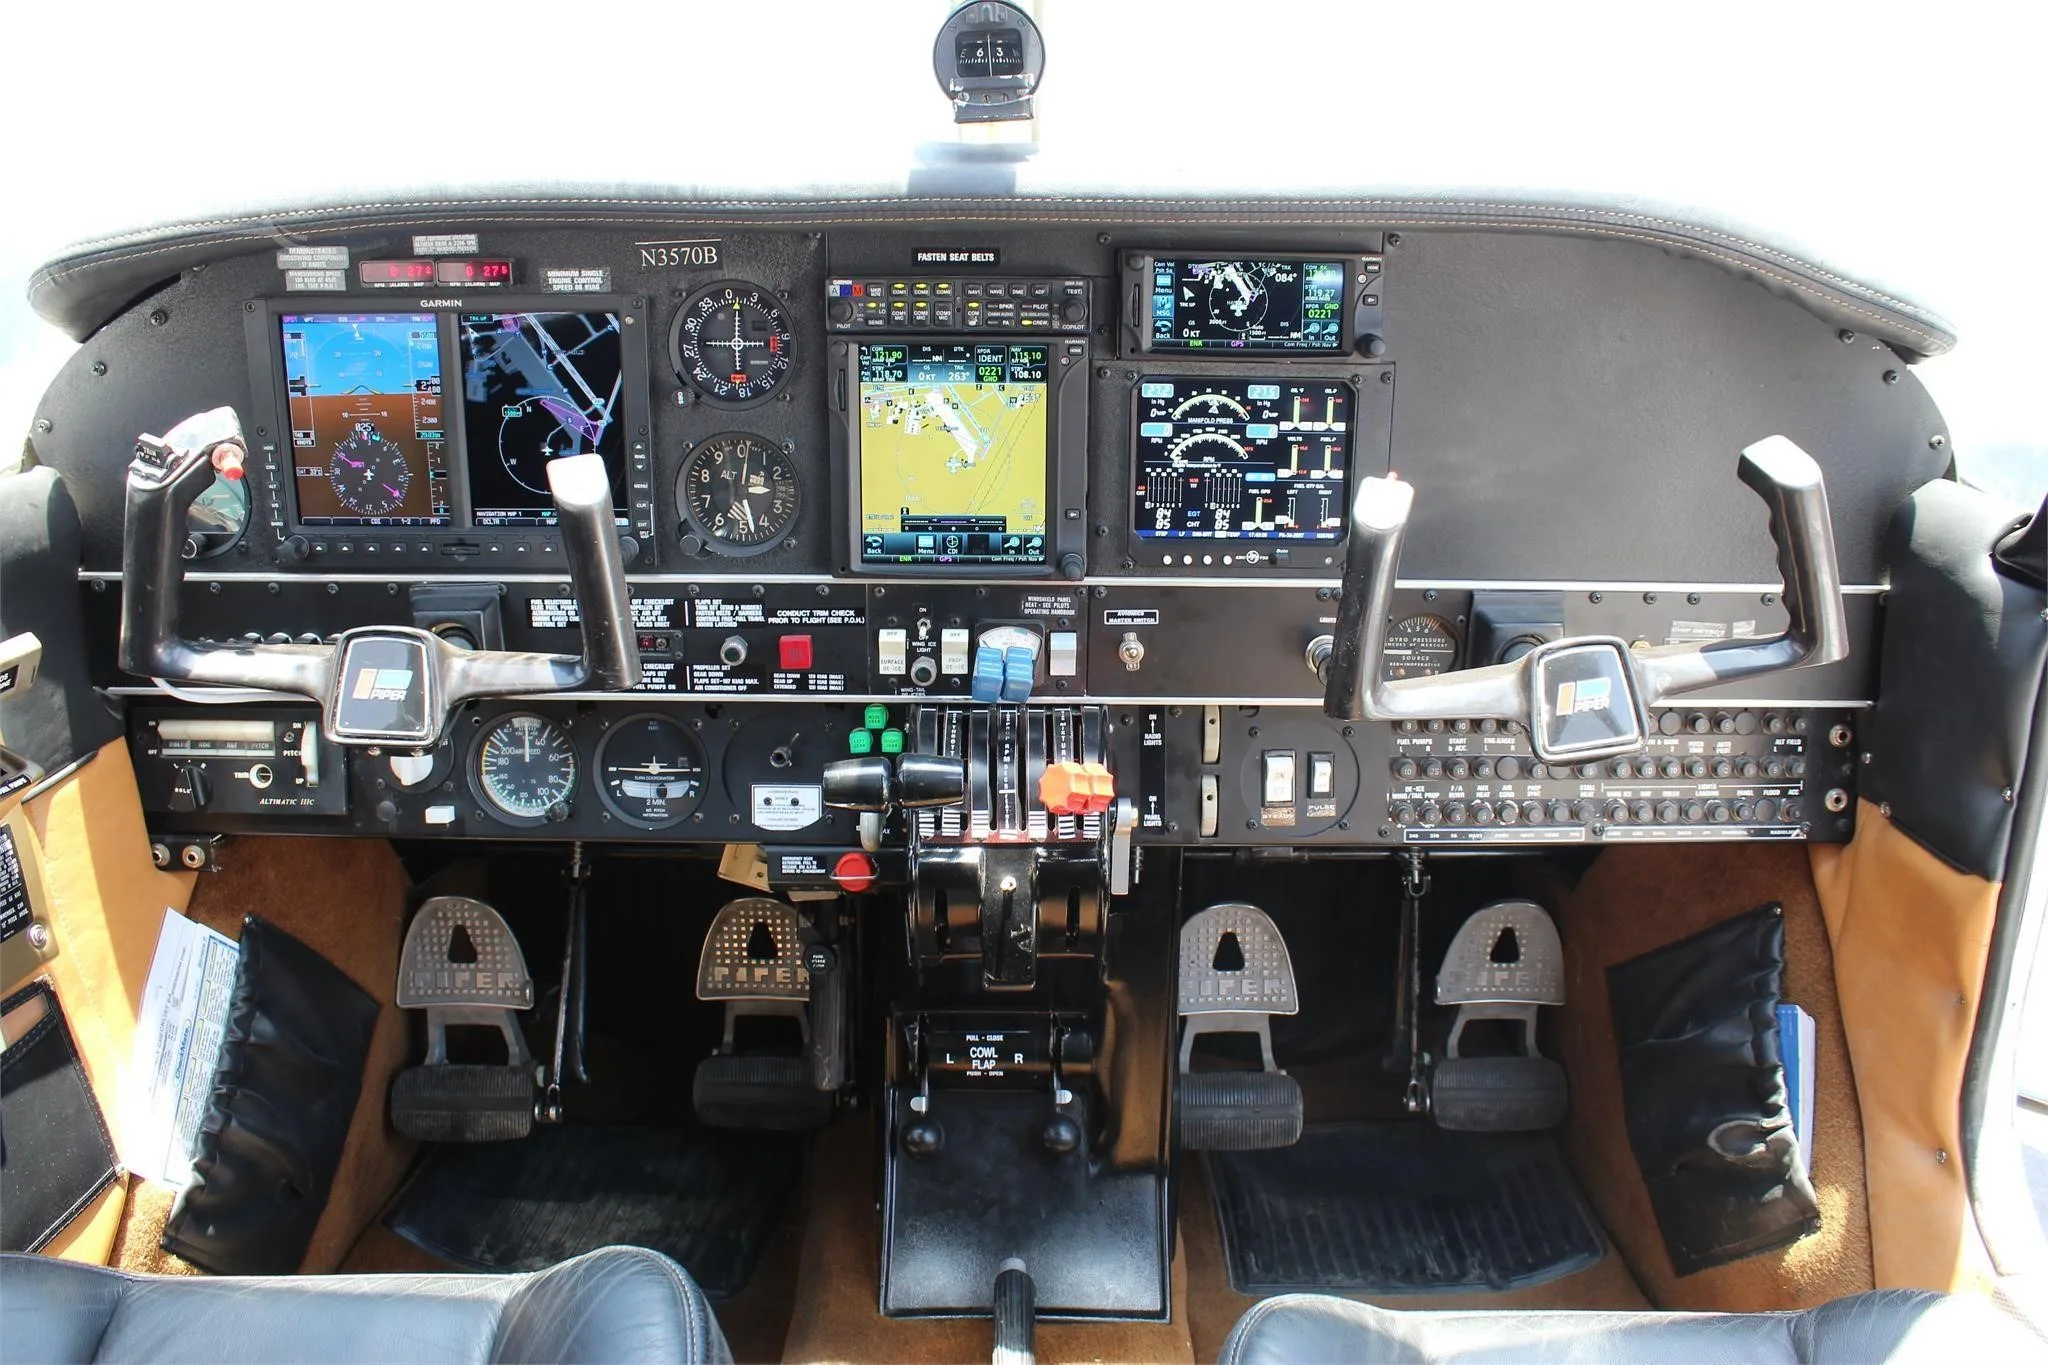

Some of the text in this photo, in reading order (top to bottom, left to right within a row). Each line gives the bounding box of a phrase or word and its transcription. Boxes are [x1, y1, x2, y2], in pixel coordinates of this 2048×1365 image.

[976, 47, 1004, 57] 6 3
[641, 247, 718, 267] N3570B
[918, 253, 994, 262] FASTEN SEAT BELTS
[725, 289, 732, 299] 0
[751, 293, 758, 302] 3
[420, 300, 462, 308] GARMIN
[699, 297, 713, 311] 33
[771, 309, 780, 317] 6
[1308, 310, 1331, 318] 0221
[685, 318, 697, 332] 30
[684, 344, 694, 357] 27
[1015, 352, 1041, 360] 115.10
[777, 357, 789, 369] 12
[693, 367, 707, 381] 24
[949, 372, 969, 380] 263°
[979, 367, 1002, 375] 0221
[762, 377, 775, 390] 15
[714, 385, 727, 395] 21
[739, 388, 752, 398] 18
[737, 444, 746, 458] 0
[714, 452, 723, 464] 9
[702, 469, 710, 482] 8
[720, 470, 737, 480] ALT
[773, 466, 781, 480] 2
[702, 495, 710, 508] 7
[774, 500, 782, 513] 3
[715, 513, 724, 526] 6
[759, 514, 769, 527] 4
[740, 521, 748, 534] 5
[370, 689, 408, 701] PIPER
[970, 1047, 998, 1058] COWL
[946, 1054, 1023, 1064] L R
[972, 1060, 996, 1069] FLAP
